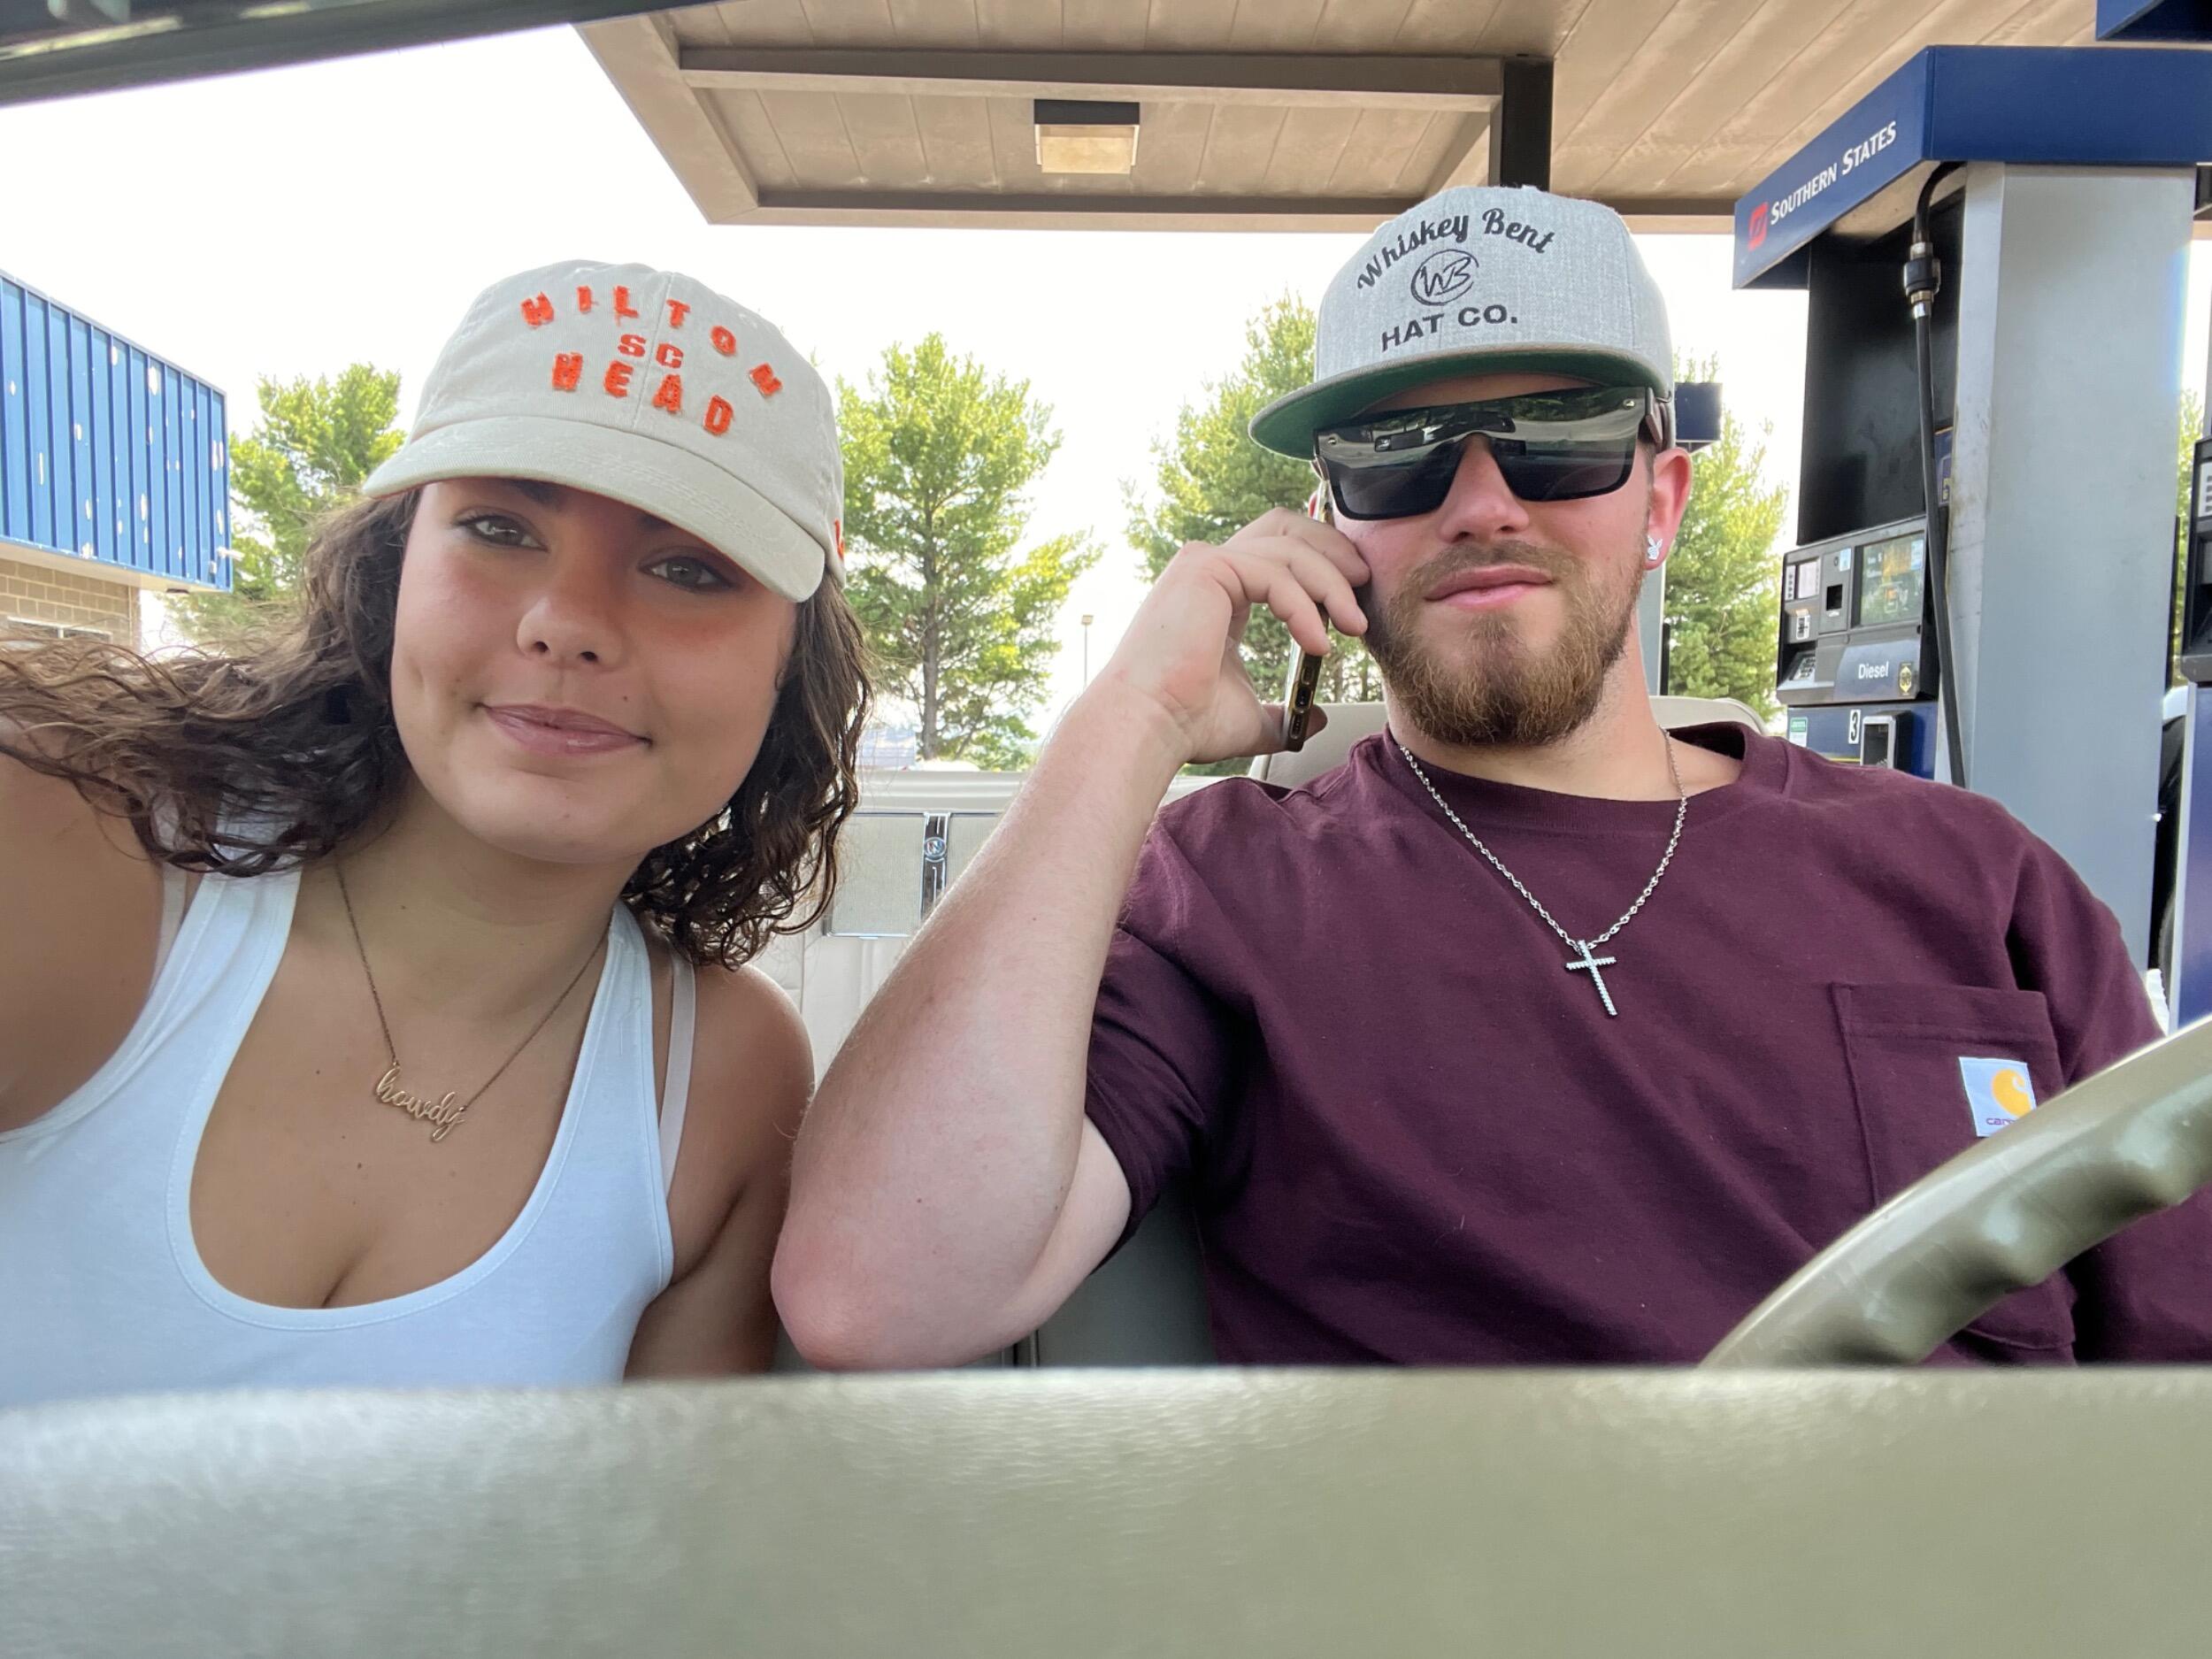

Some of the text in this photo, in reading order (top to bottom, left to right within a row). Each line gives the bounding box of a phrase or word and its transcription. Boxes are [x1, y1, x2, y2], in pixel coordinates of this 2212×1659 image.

[1357, 207, 1555, 289] Whiskey Bent
[520, 285, 783, 399] HILTON
[618, 334, 684, 369] SC
[1381, 304, 1518, 352] HAT CO.
[552, 351, 734, 436] HEAD
[1858, 661, 1889, 680] Diesel
[1850, 711, 1859, 742] 3
[374, 1065, 466, 1143] howdy
